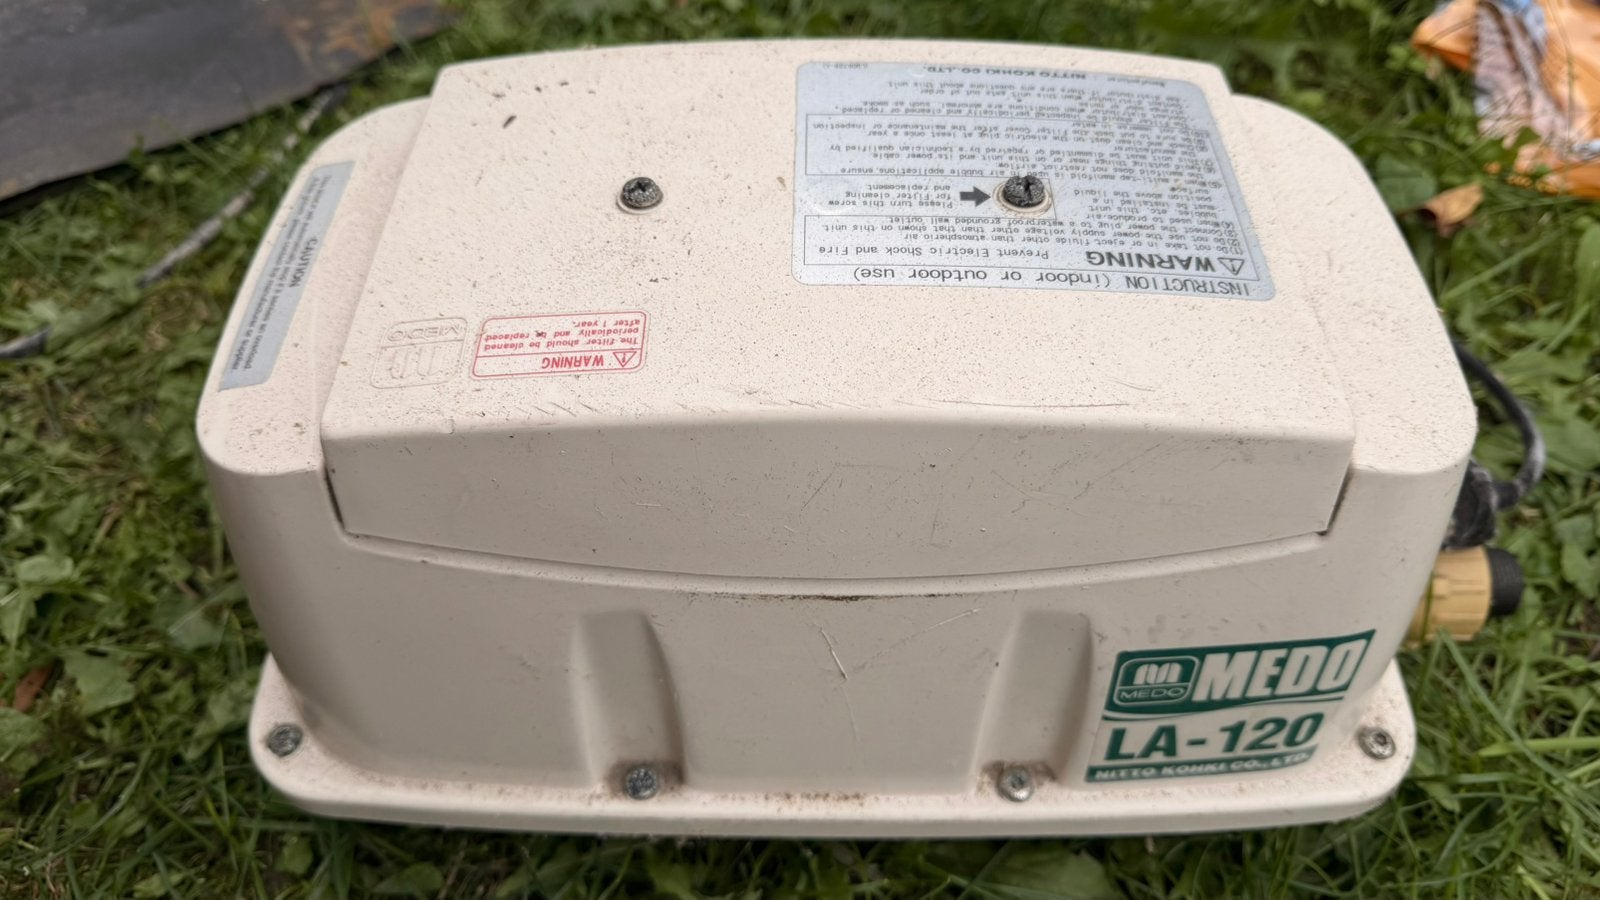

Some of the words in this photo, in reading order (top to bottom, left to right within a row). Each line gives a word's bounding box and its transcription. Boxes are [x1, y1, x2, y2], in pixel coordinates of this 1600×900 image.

[954, 216, 1000, 225] grounded
[1097, 221, 1120, 230] plug
[1021, 226, 1064, 236] voltage
[1071, 228, 1105, 238] supply
[1112, 230, 1140, 239] power
[1021, 234, 1049, 243] other
[1055, 236, 1089, 245] fluids
[1145, 232, 1162, 241] the
[1190, 235, 1208, 244] not
[818, 246, 848, 255] Fire
[856, 246, 877, 255] and
[886, 246, 921, 255] Shock
[1164, 241, 1187, 250] take
[928, 247, 988, 257] Electric
[996, 248, 1048, 258] Prevent
[289, 238, 318, 288] CAUTION
[1085, 250, 1214, 272] WARNING
[853, 267, 894, 281] use)
[908, 268, 987, 281] outdoor
[1000, 271, 1021, 280] or
[1035, 271, 1110, 288] (indoor
[1125, 276, 1248, 295] INSTRUCTION
[614, 319, 640, 328] after
[579, 327, 639, 338] periodically
[484, 342, 523, 352] cleaned
[529, 341, 540, 350] be
[586, 337, 615, 347] filter
[542, 354, 604, 369] WARNING
[1192, 638, 1368, 702] MEDO
[1120, 686, 1185, 699] MEDO
[1104, 712, 1325, 761] LA-120
[1095, 768, 1156, 780] NITTO
[1161, 763, 1227, 776] KOHKI
